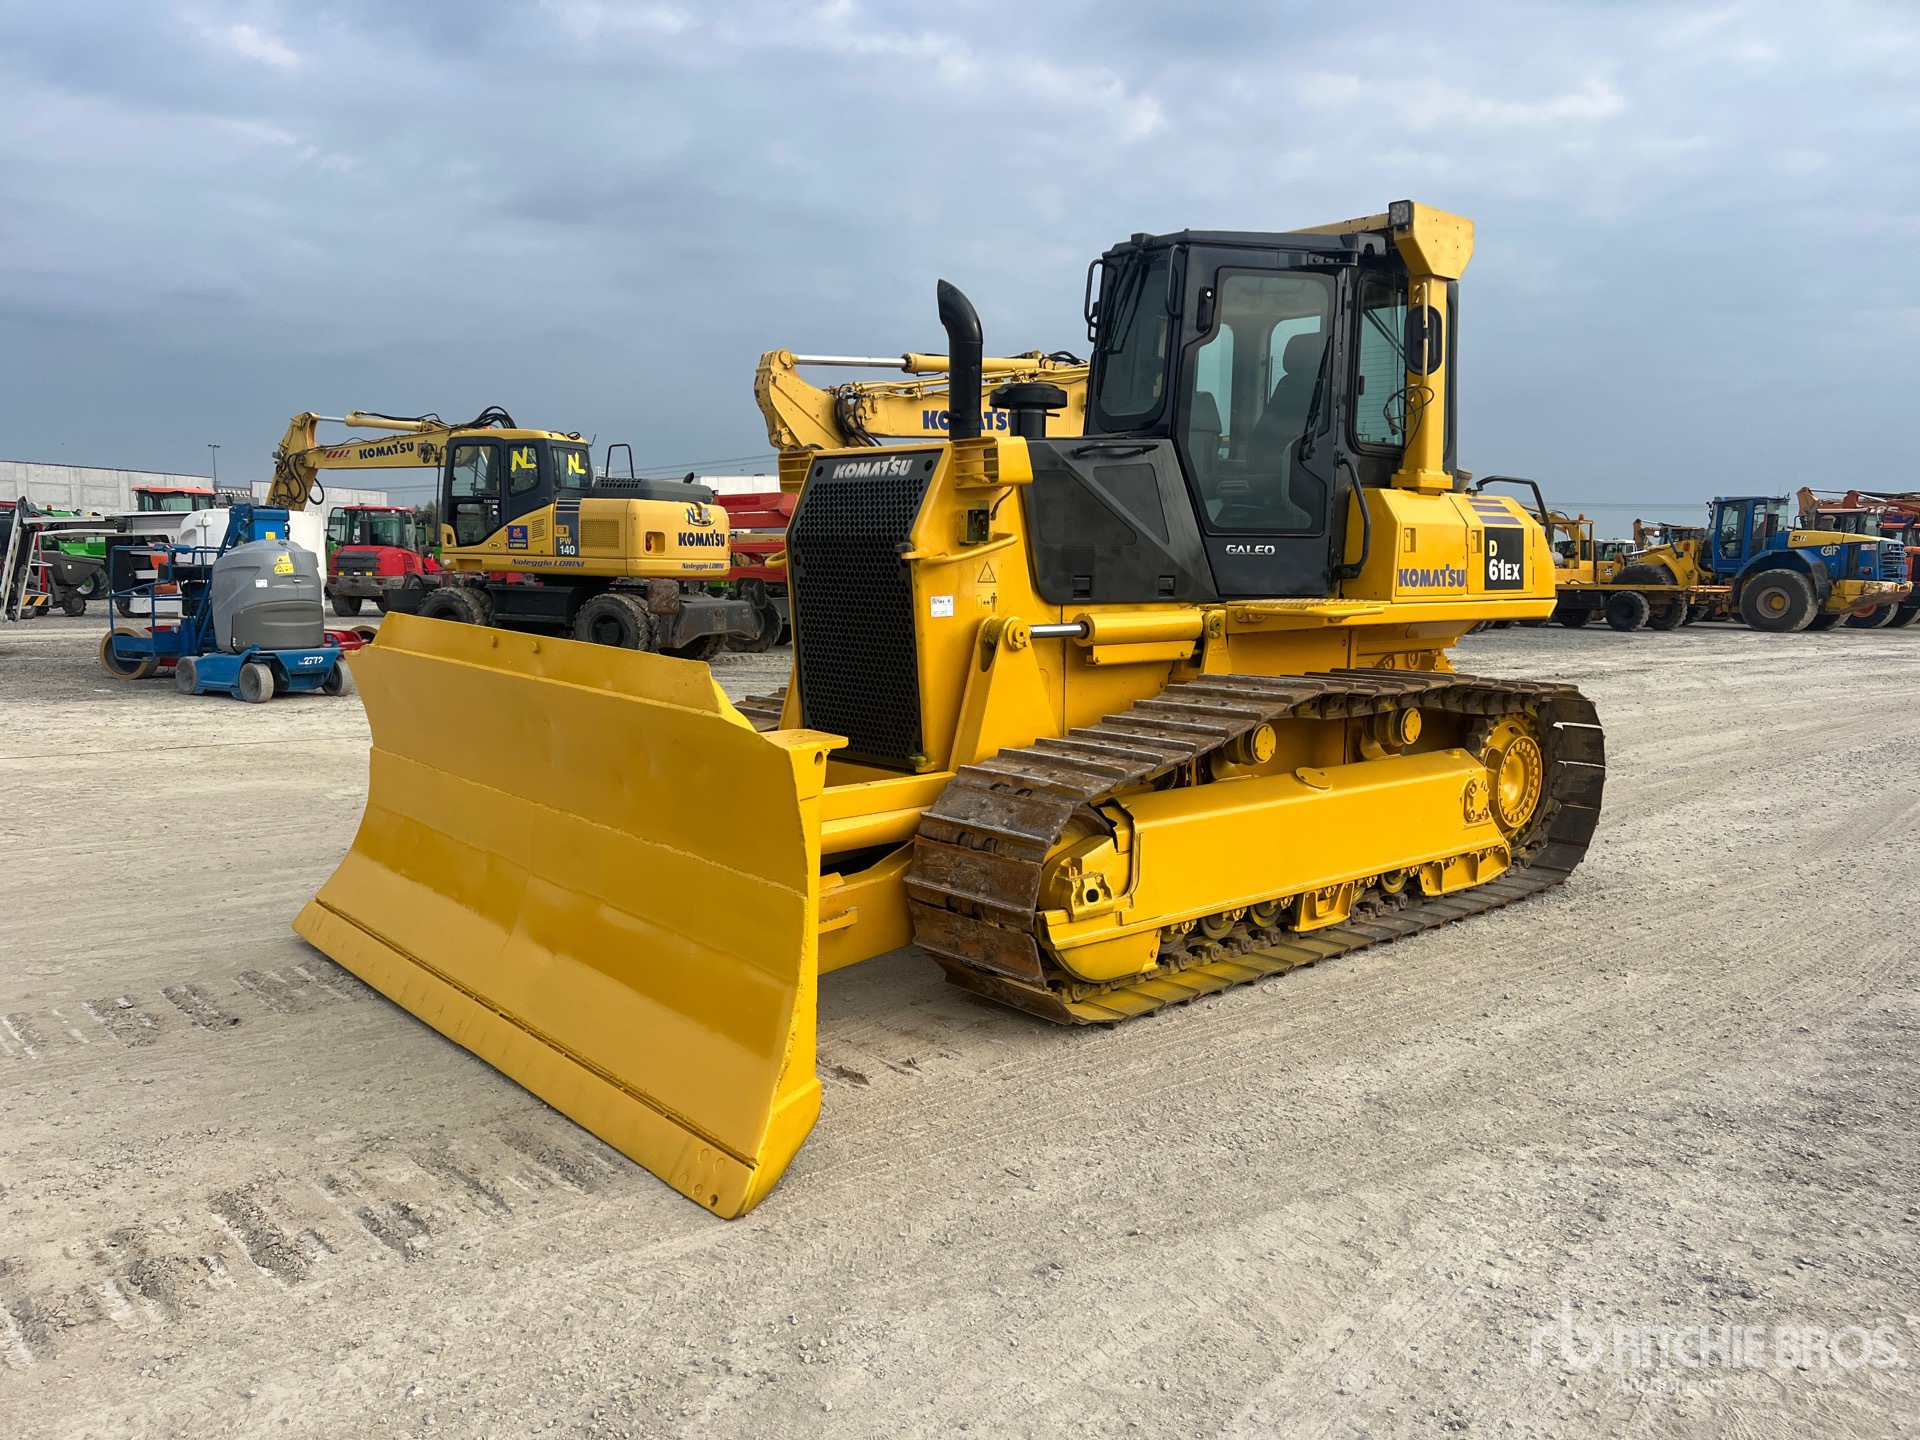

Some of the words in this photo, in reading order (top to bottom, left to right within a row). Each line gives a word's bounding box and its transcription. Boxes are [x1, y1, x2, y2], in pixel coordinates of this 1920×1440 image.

[359, 441, 414, 459] KOMATSU
[832, 456, 913, 479] KOMATSU
[559, 537, 571, 545] PW
[678, 529, 725, 547] KOMATSU
[559, 545, 576, 555] 140
[1225, 544, 1276, 556] GALEO
[1488, 540, 1498, 557] D
[511, 558, 552, 567] Noleggio
[553, 560, 585, 568] LORINI
[1488, 559, 1521, 581] 61EX
[1398, 564, 1466, 588] KOMATSU
